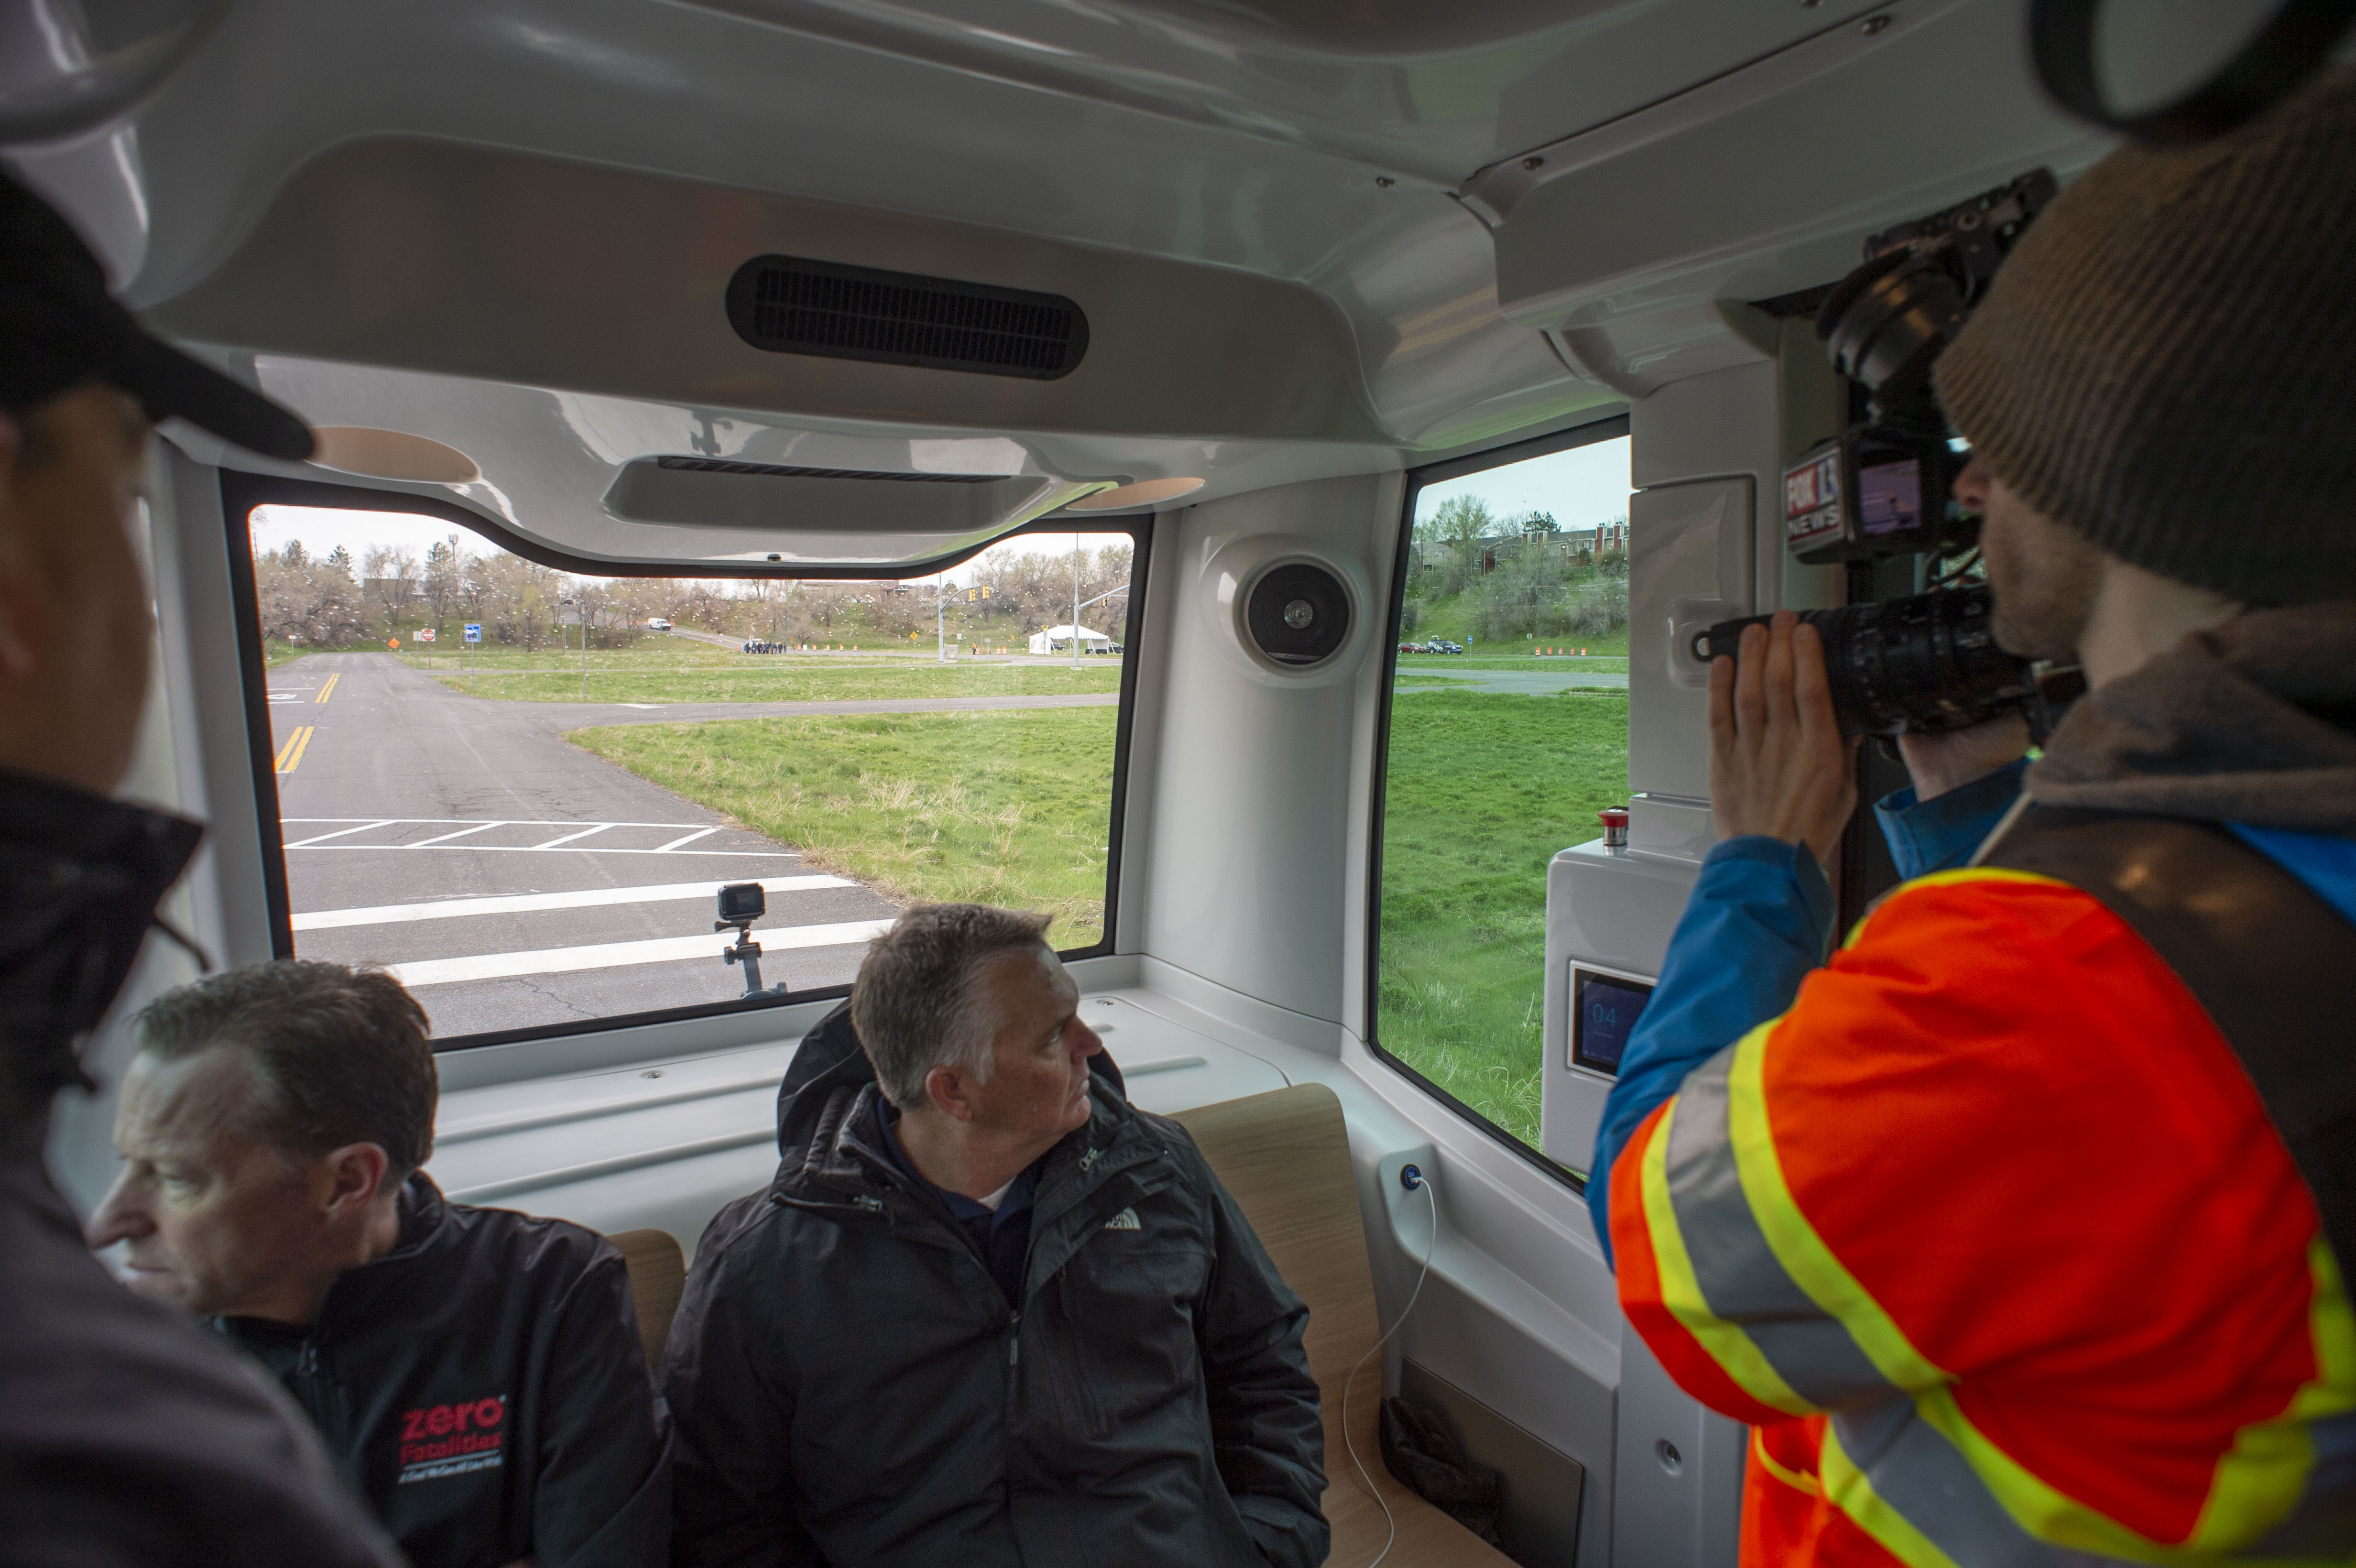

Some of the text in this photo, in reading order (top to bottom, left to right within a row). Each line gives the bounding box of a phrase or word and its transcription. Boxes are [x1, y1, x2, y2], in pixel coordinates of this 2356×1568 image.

[1787, 469, 1816, 513] FOX
[1788, 505, 1839, 534] NEWS
[1592, 1003, 1616, 1027] 04
[401, 1397, 503, 1441] zero
